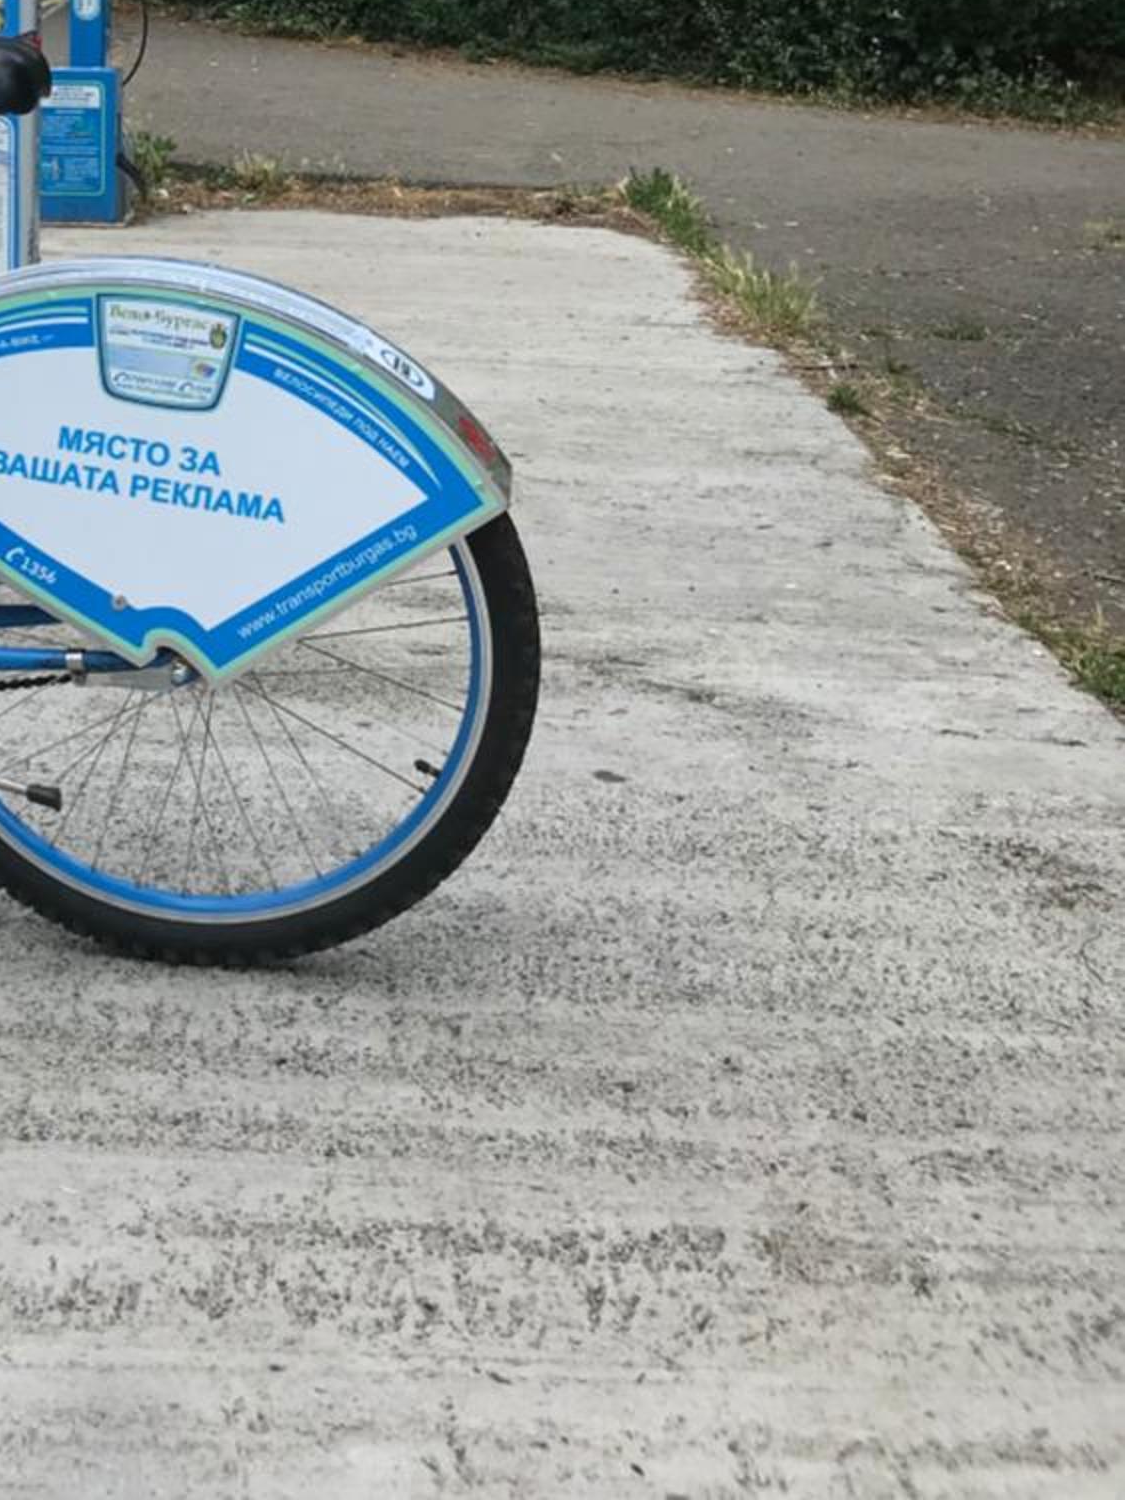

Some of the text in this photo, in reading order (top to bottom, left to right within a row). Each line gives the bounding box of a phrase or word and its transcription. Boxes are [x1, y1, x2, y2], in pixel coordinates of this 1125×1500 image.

[58, 425, 220, 476] МЯСТО ЗА
[129, 473, 284, 523] РЕКЛАМА
[19, 556, 58, 585] 1356
[236, 524, 418, 640] www.transportburgas.bg
